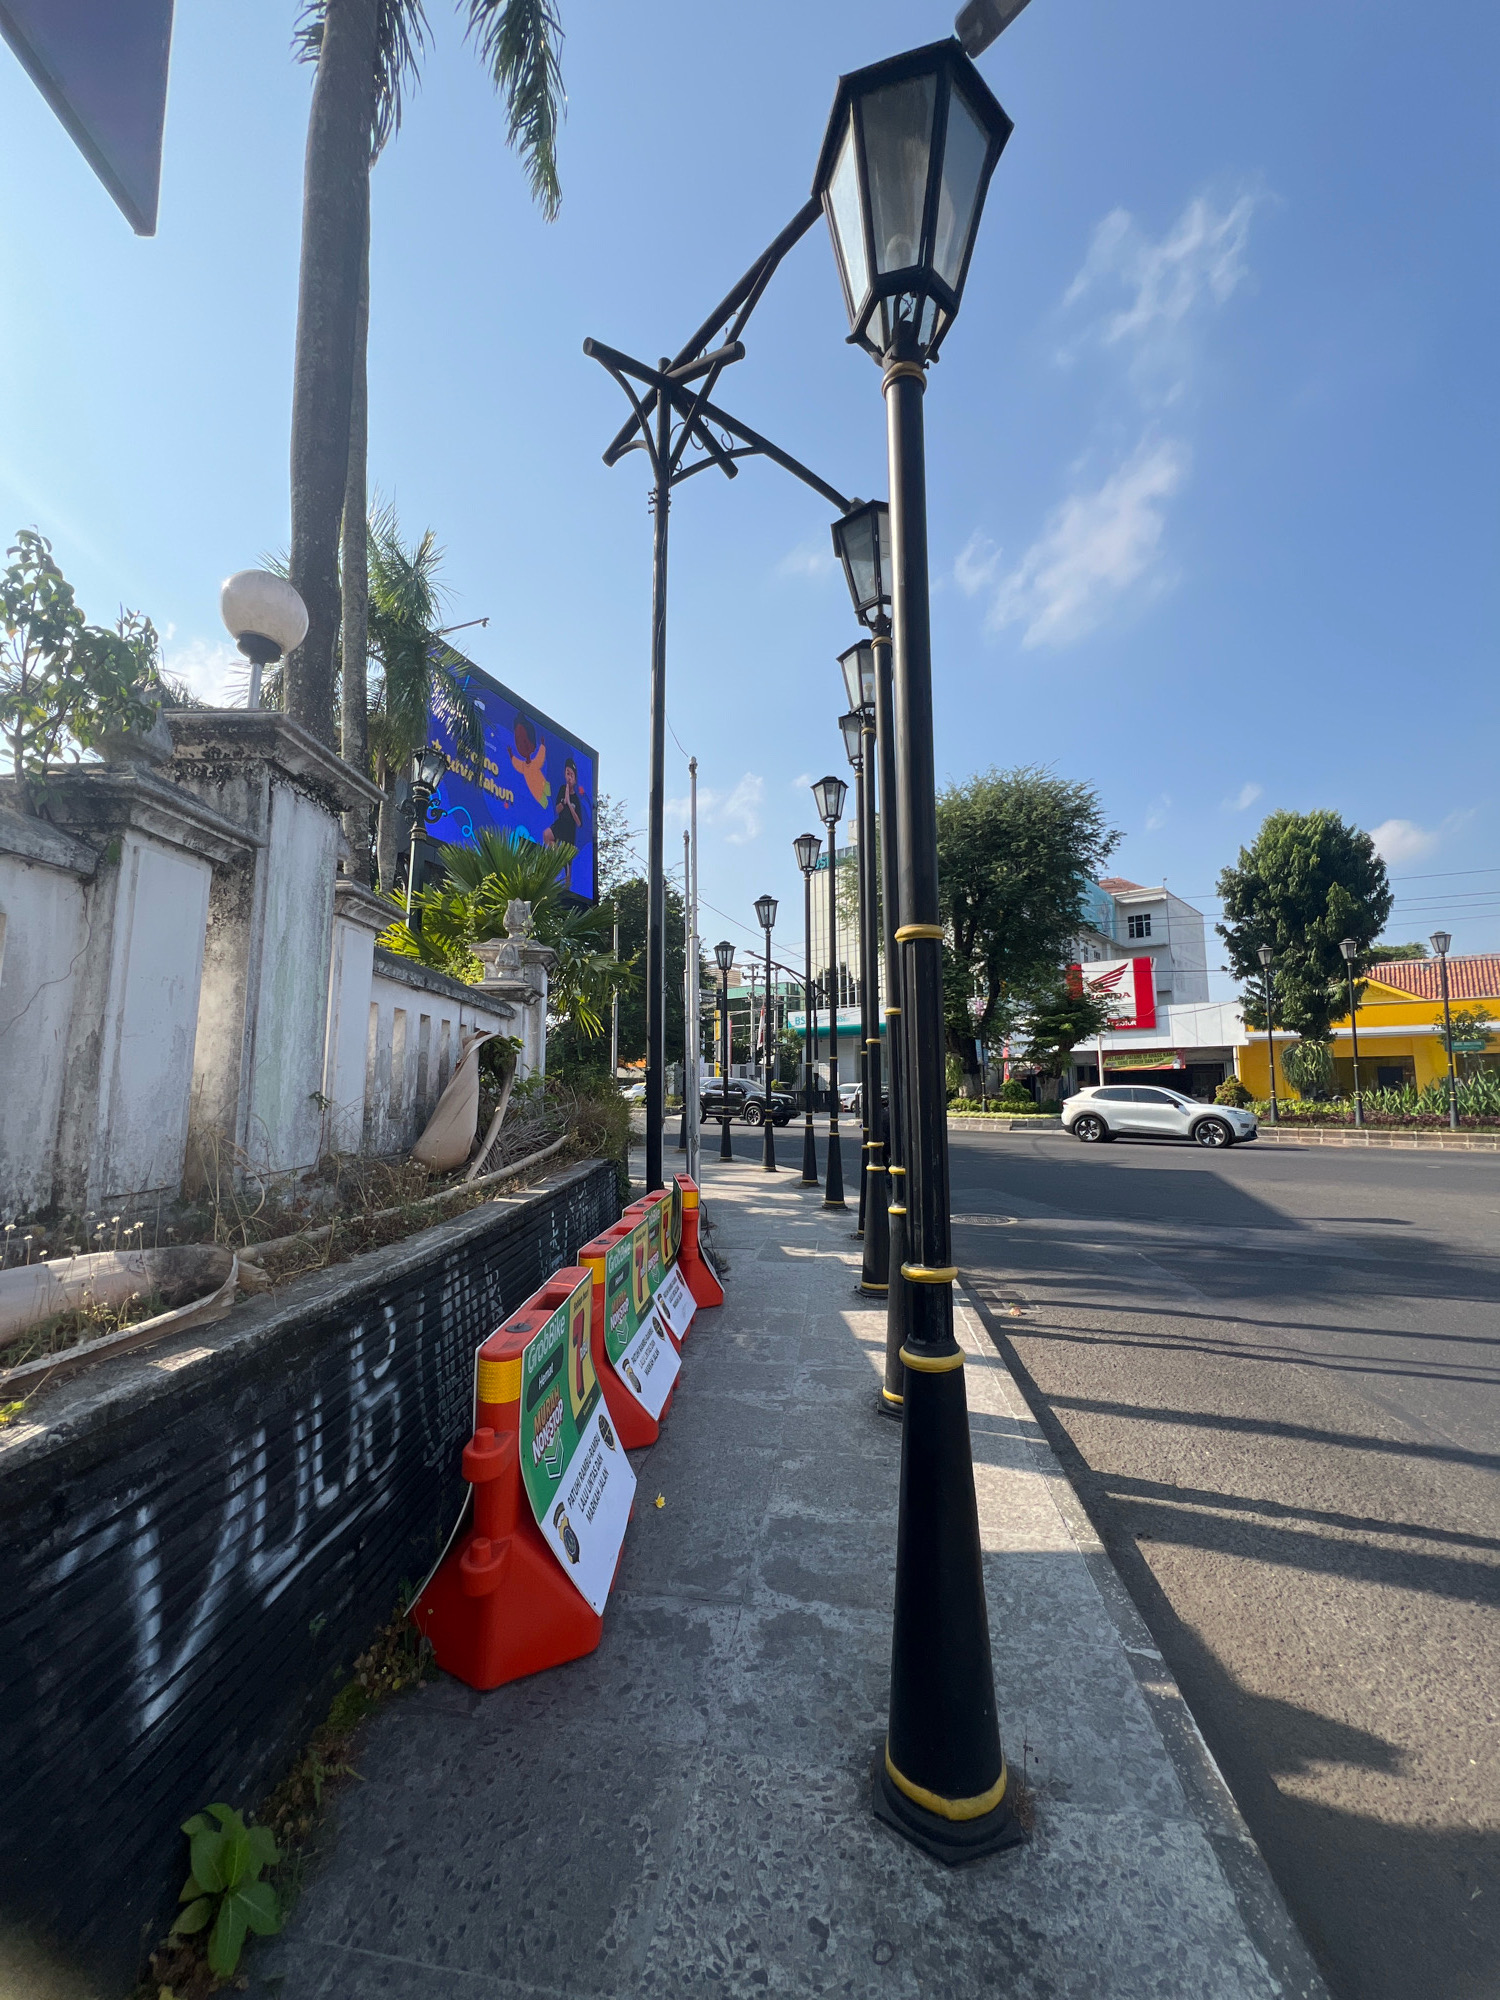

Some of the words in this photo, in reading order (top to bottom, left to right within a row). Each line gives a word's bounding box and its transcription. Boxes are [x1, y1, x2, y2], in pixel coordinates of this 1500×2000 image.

[527, 1314, 566, 1374] GrabBike
[538, 1362, 554, 1390] Hemat
[534, 1383, 560, 1436] MURAH
[567, 1475, 582, 1509] PATUHI
[578, 1431, 601, 1482] RAMBU-RAMBU
[578, 1487, 589, 1513] LALU
[586, 1464, 598, 1494] LINTAS
[595, 1451, 603, 1471] DAN
[586, 1486, 601, 1524] MARKAH
[598, 1466, 609, 1492] JALAN
